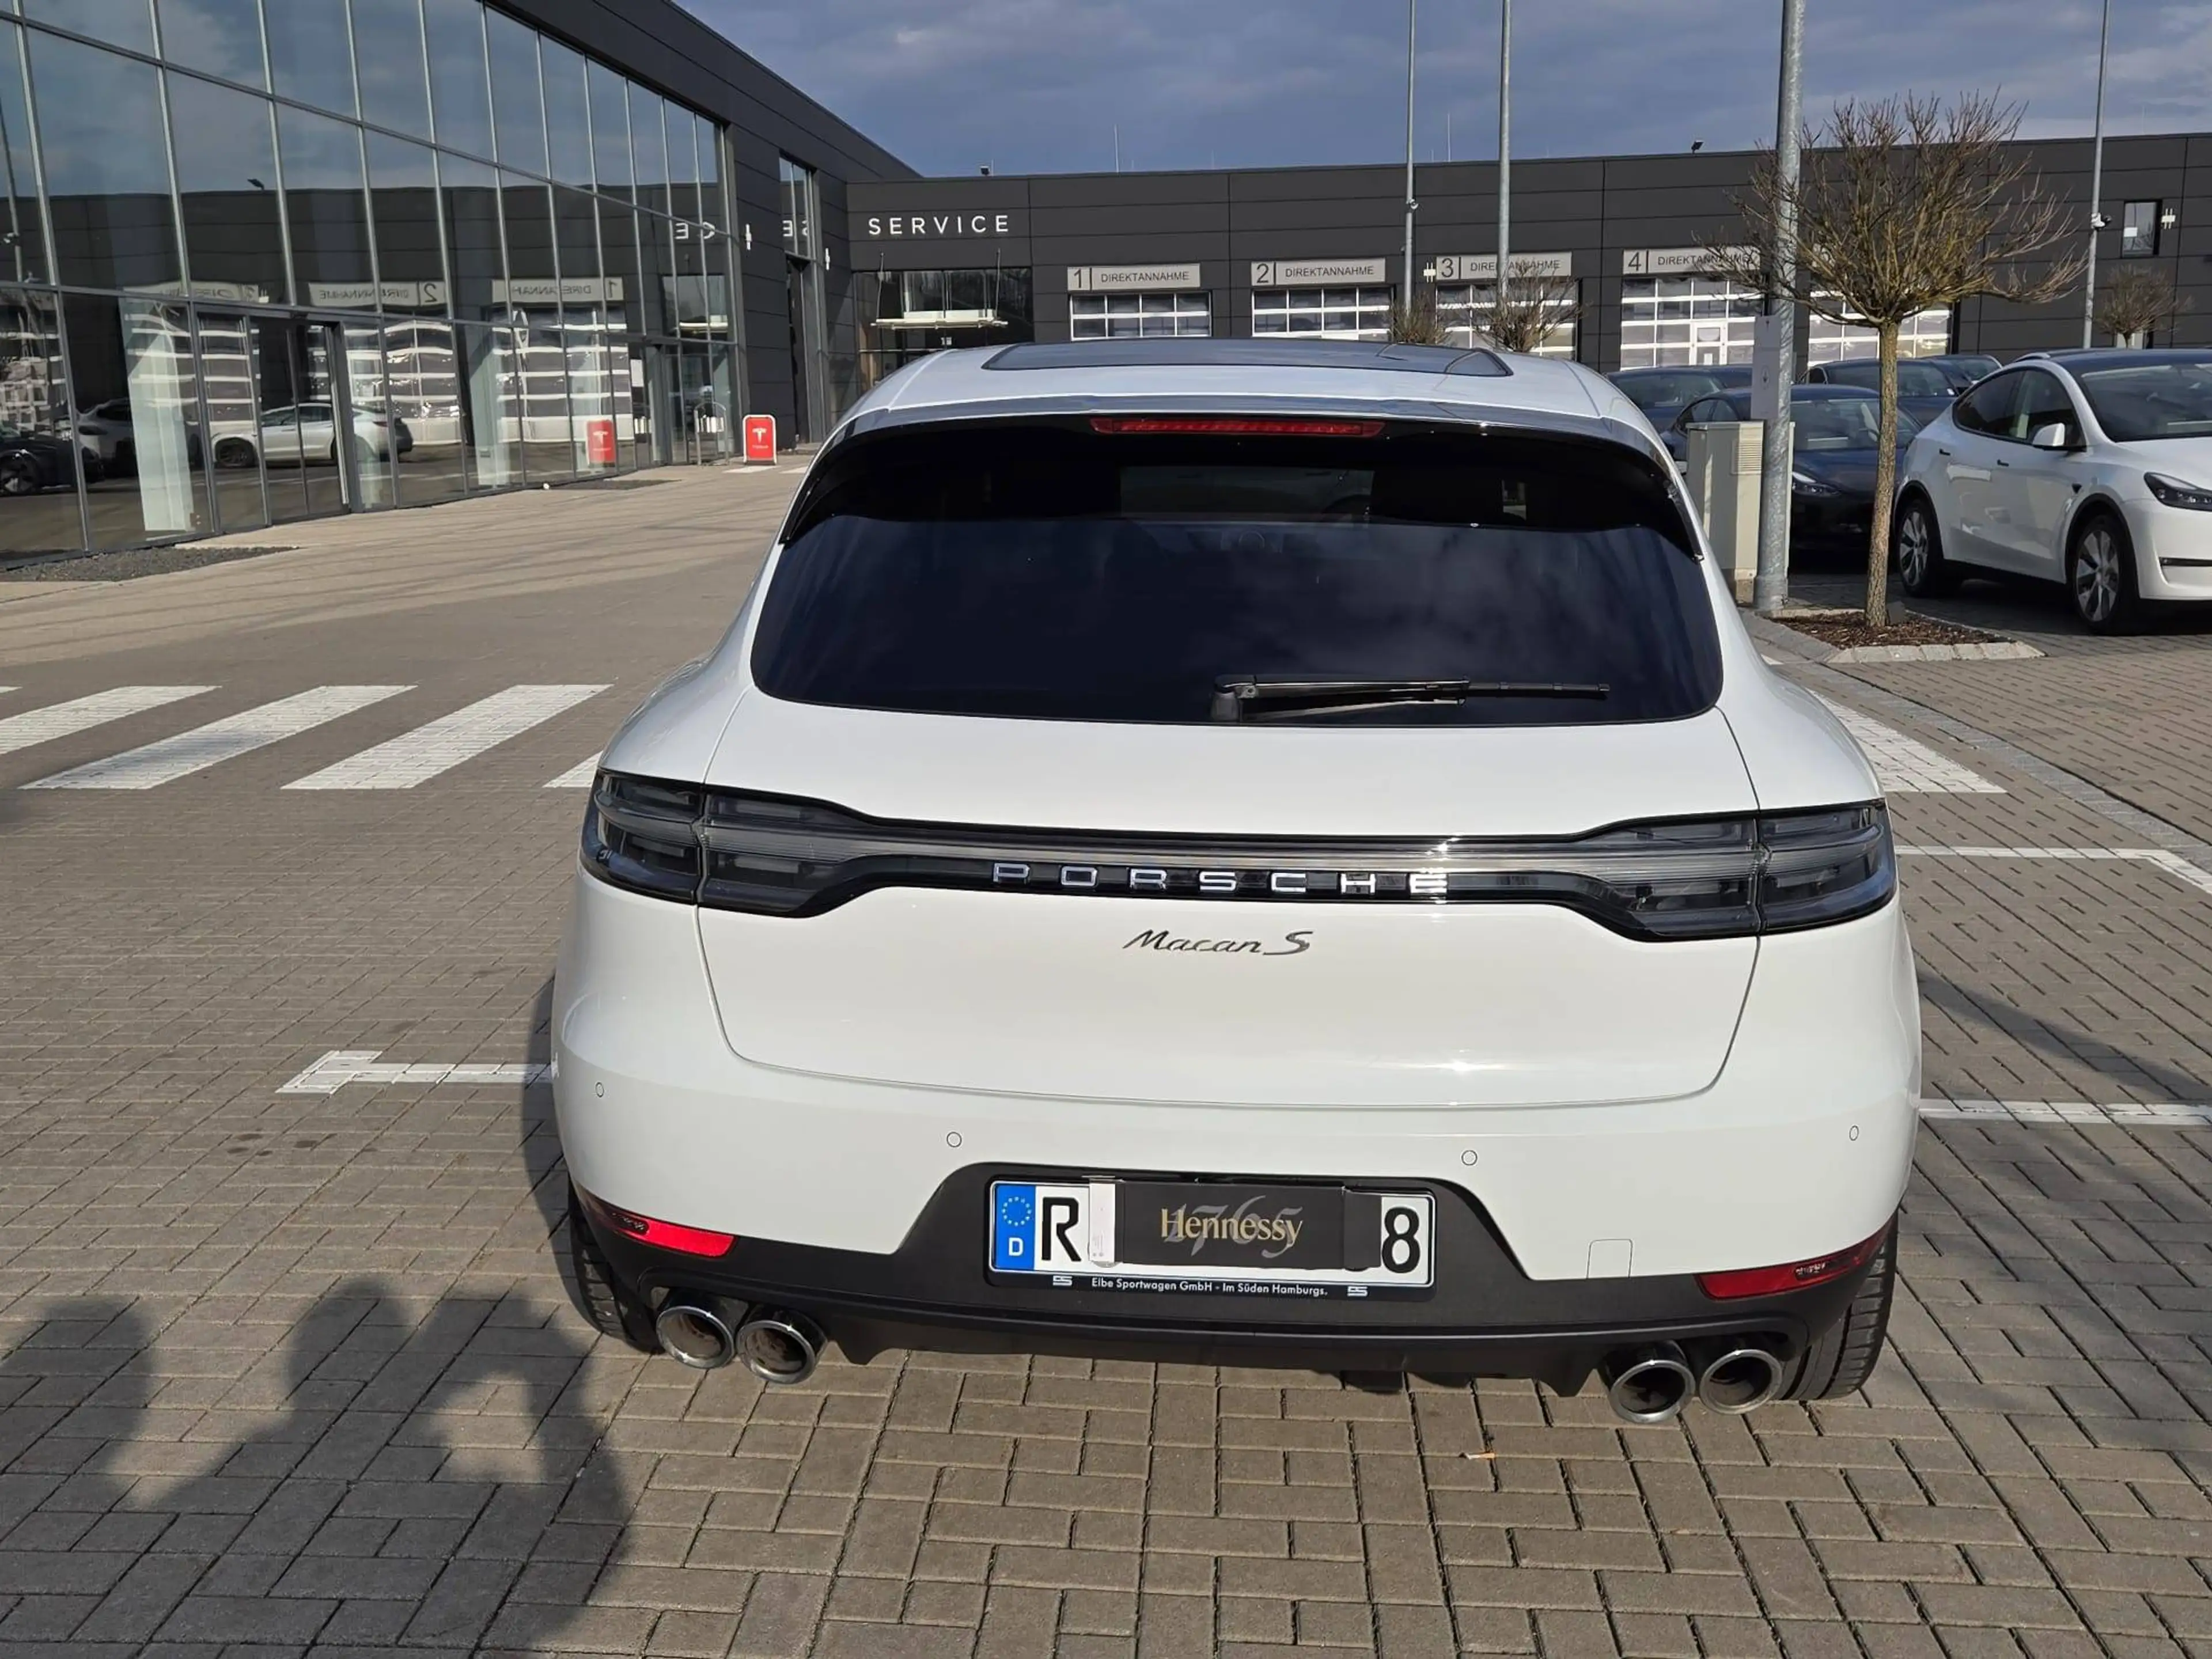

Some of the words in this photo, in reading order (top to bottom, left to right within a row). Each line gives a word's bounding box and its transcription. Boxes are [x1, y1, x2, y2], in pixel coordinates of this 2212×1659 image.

[868, 215, 1009, 235] SERVICE
[1441, 257, 1453, 278] 3
[1470, 260, 1561, 271] DIREANNAHME
[1628, 252, 1642, 271] 4
[1074, 268, 1082, 289] 1
[1101, 271, 1190, 282] DIREKTANNAHME
[1256, 263, 1270, 284] 2
[1285, 266, 1374, 278] DIREKTANNAHME
[993, 863, 1448, 894] PORSCHE
[1122, 929, 1262, 953] Macan
[1263, 931, 1313, 956] S
[1041, 1196, 1082, 1262] R
[1382, 1207, 1421, 1274] 8
[1160, 1208, 1304, 1248] Hennessy
[1009, 1237, 1024, 1256] D
[1092, 1277, 1113, 1288] Elbe
[1116, 1278, 1177, 1292] Sportwagen
[1179, 1281, 1213, 1292] GmbH
[1222, 1282, 1235, 1293] Im
[1237, 1282, 1270, 1293] Süden
[1272, 1283, 1328, 1297] Hamburgs.
